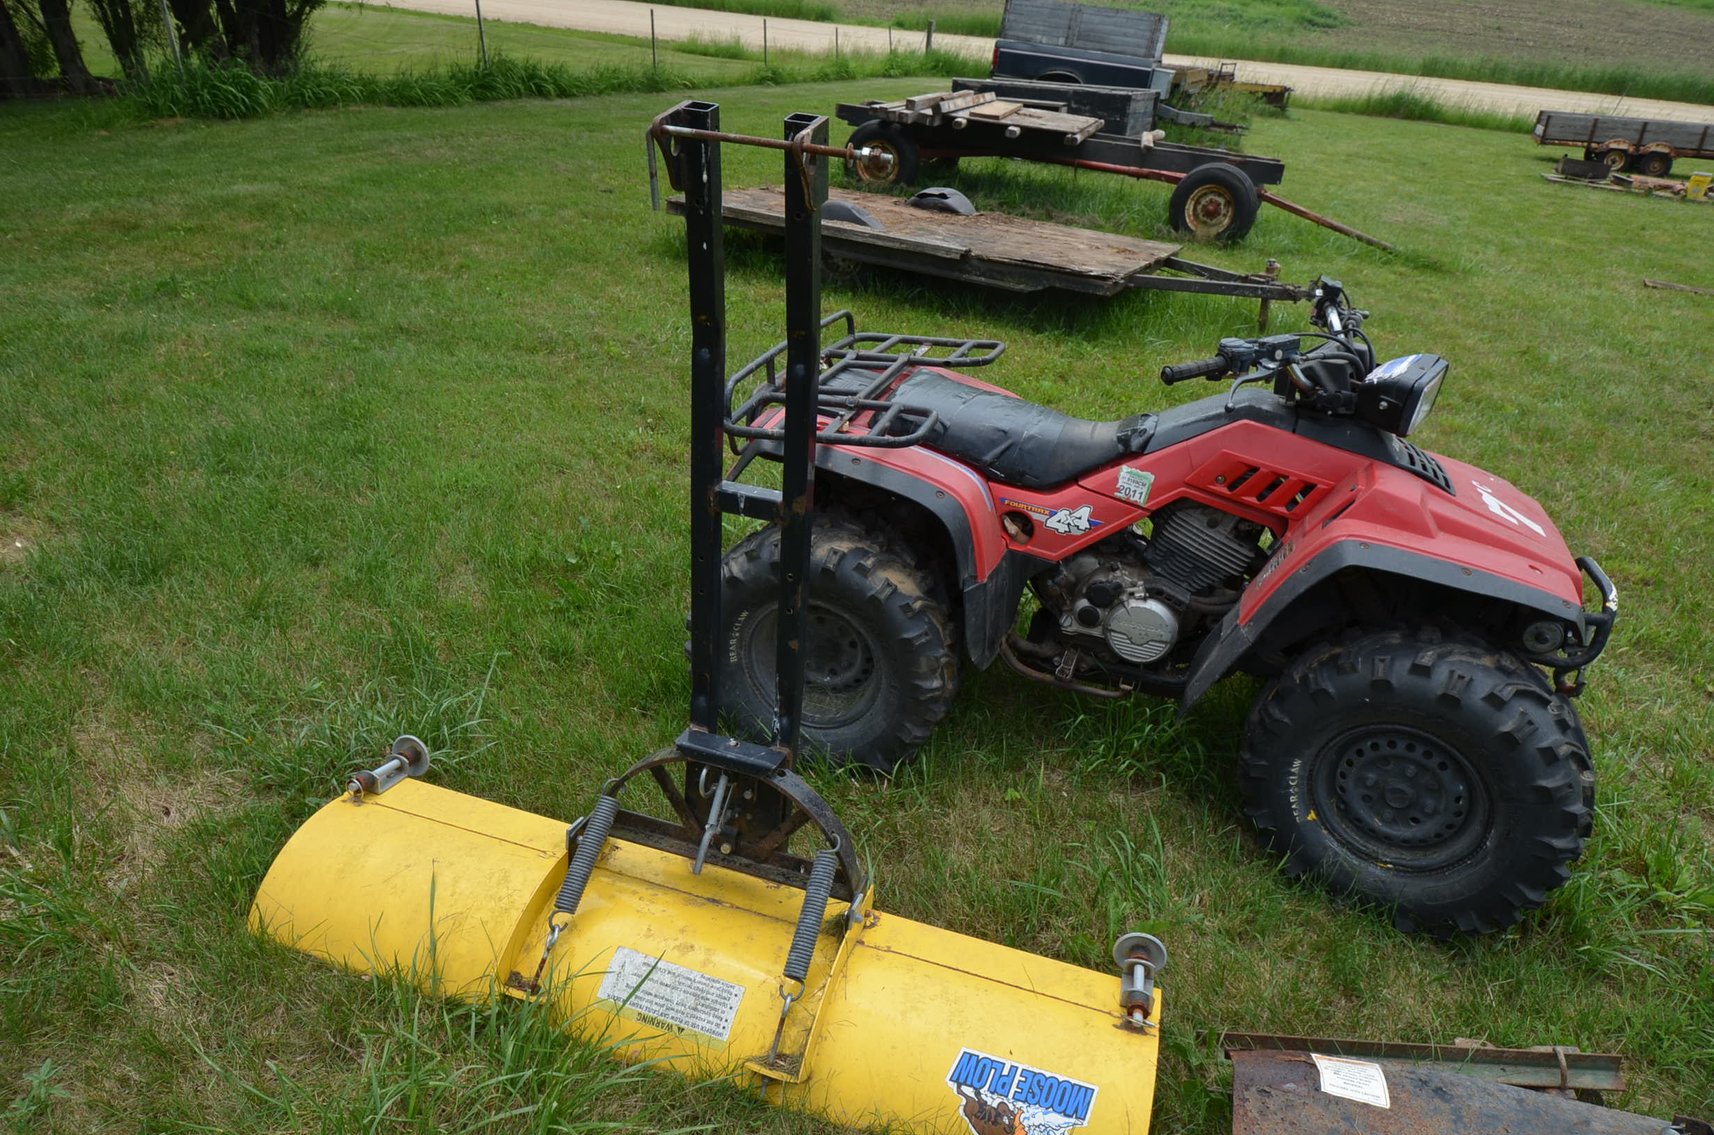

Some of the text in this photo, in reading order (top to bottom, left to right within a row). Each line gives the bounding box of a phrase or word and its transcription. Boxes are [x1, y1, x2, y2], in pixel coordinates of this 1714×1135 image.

[1118, 484, 1144, 500] 2011
[1004, 500, 1051, 516] FOURTRAX
[729, 638, 738, 664] BEAR
[1288, 758, 1303, 786] CLAW
[635, 1012, 674, 1032] WARNING
[669, 1014, 684, 1024] PLOW
[949, 1051, 1095, 1121] MOOSE PLOW
